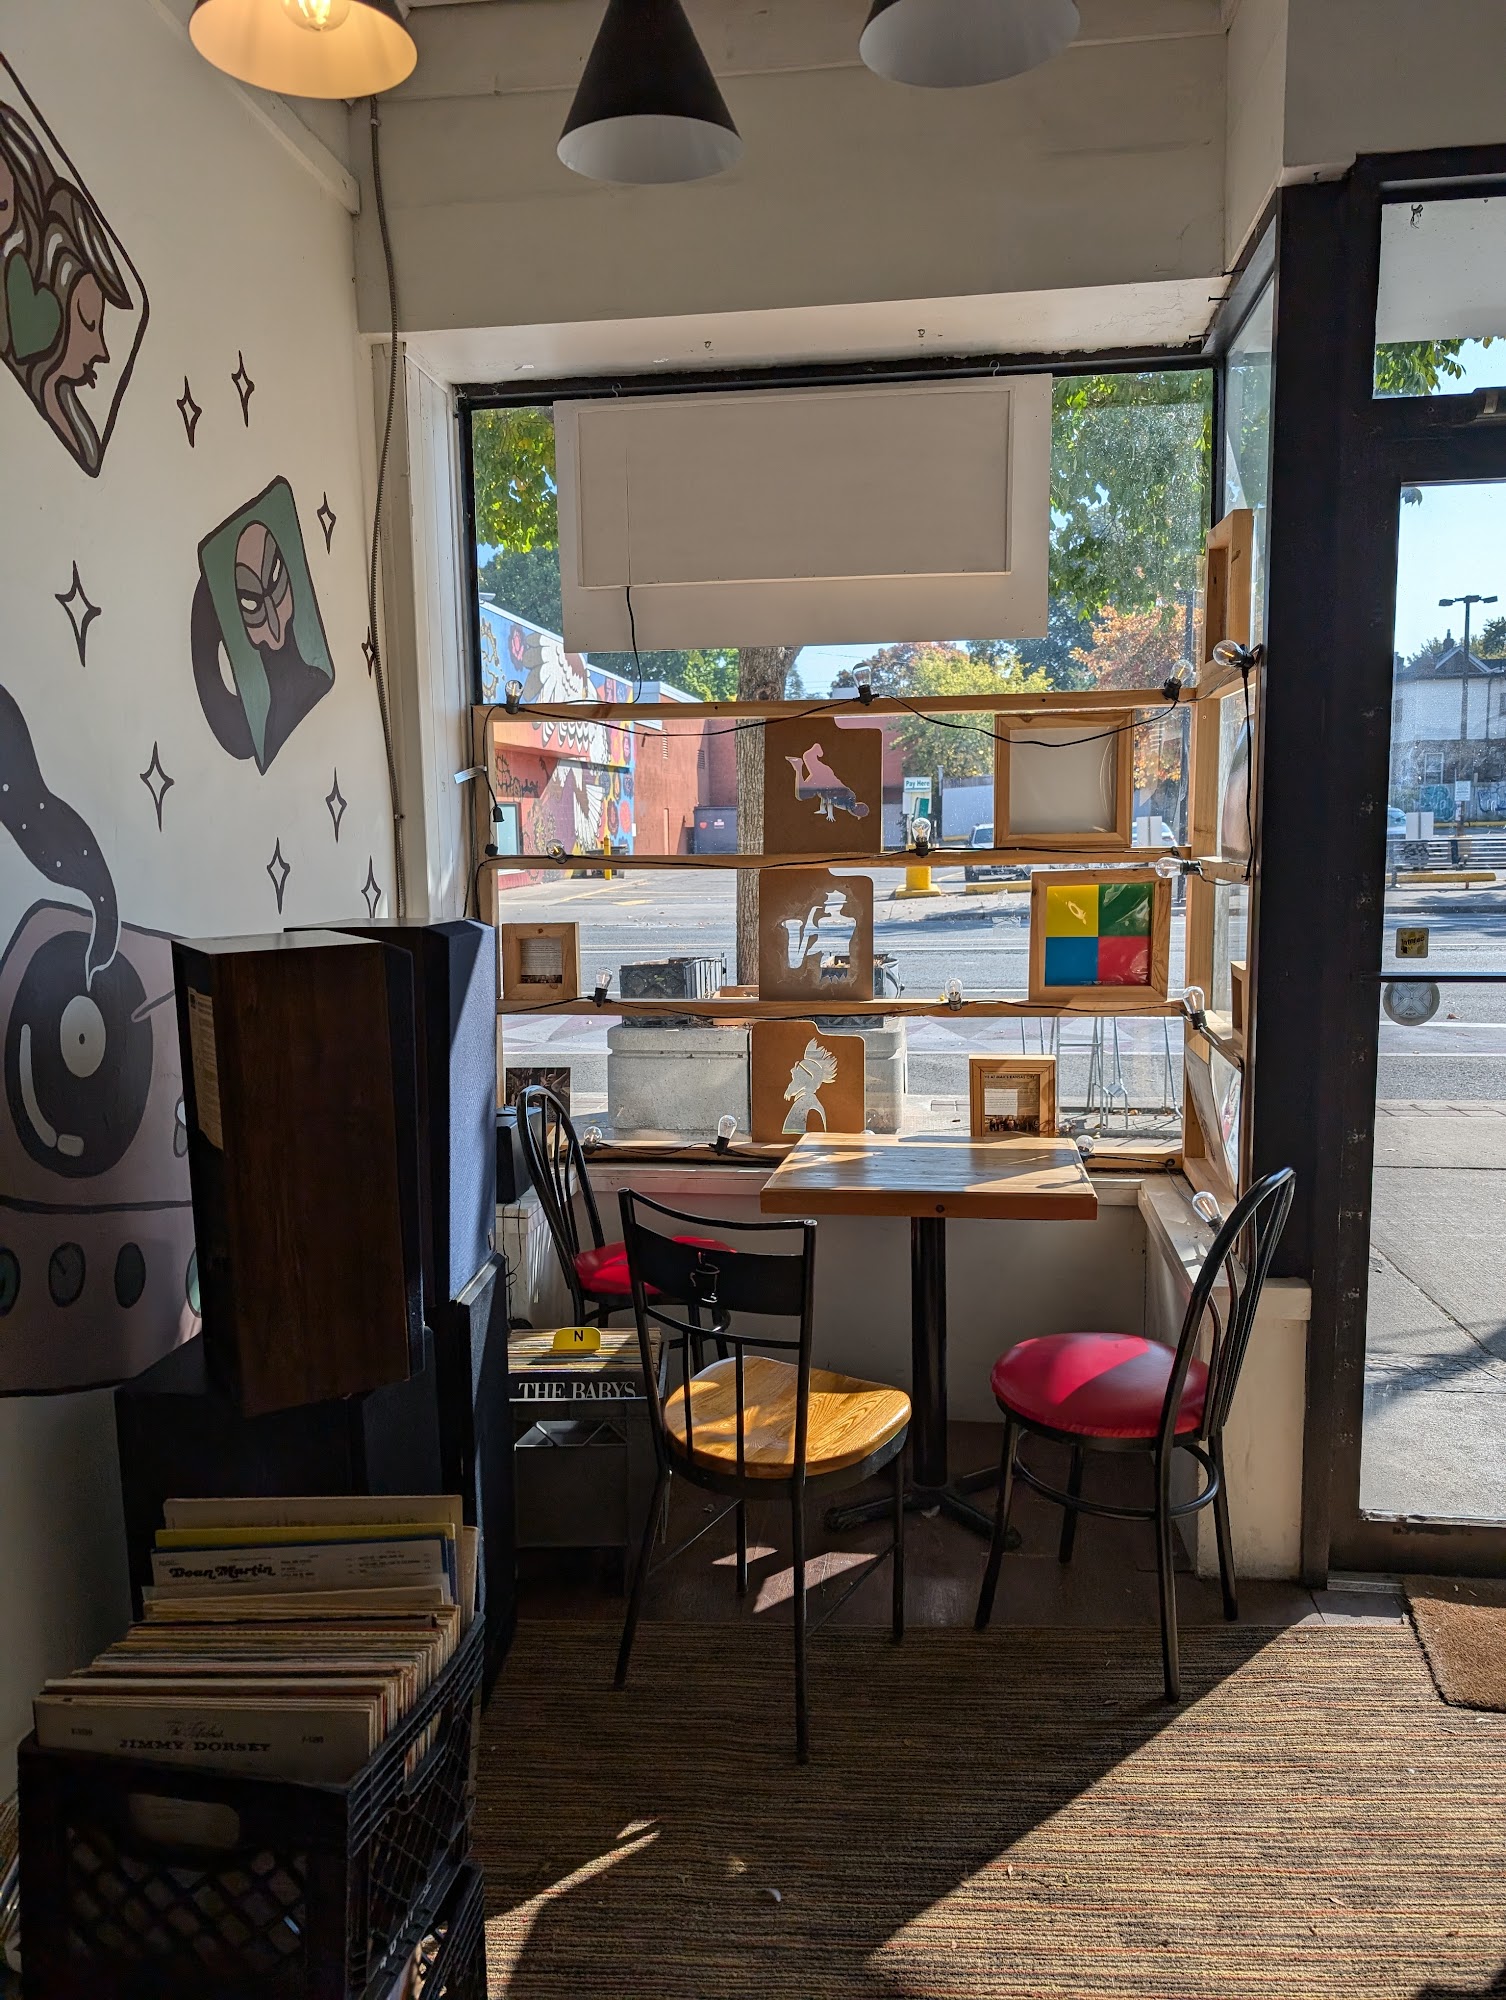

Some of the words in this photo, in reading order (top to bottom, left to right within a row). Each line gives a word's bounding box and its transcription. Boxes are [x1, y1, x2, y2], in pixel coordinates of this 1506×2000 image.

[905, 780, 915, 788] Pay
[574, 1330, 584, 1342] N
[518, 1382, 566, 1399] THE
[570, 1381, 636, 1399] BABYS
[168, 1566, 217, 1580] Dean
[215, 1564, 277, 1579] Martin
[119, 1739, 185, 1750] JIMMY
[193, 1741, 272, 1752] DORSEY
